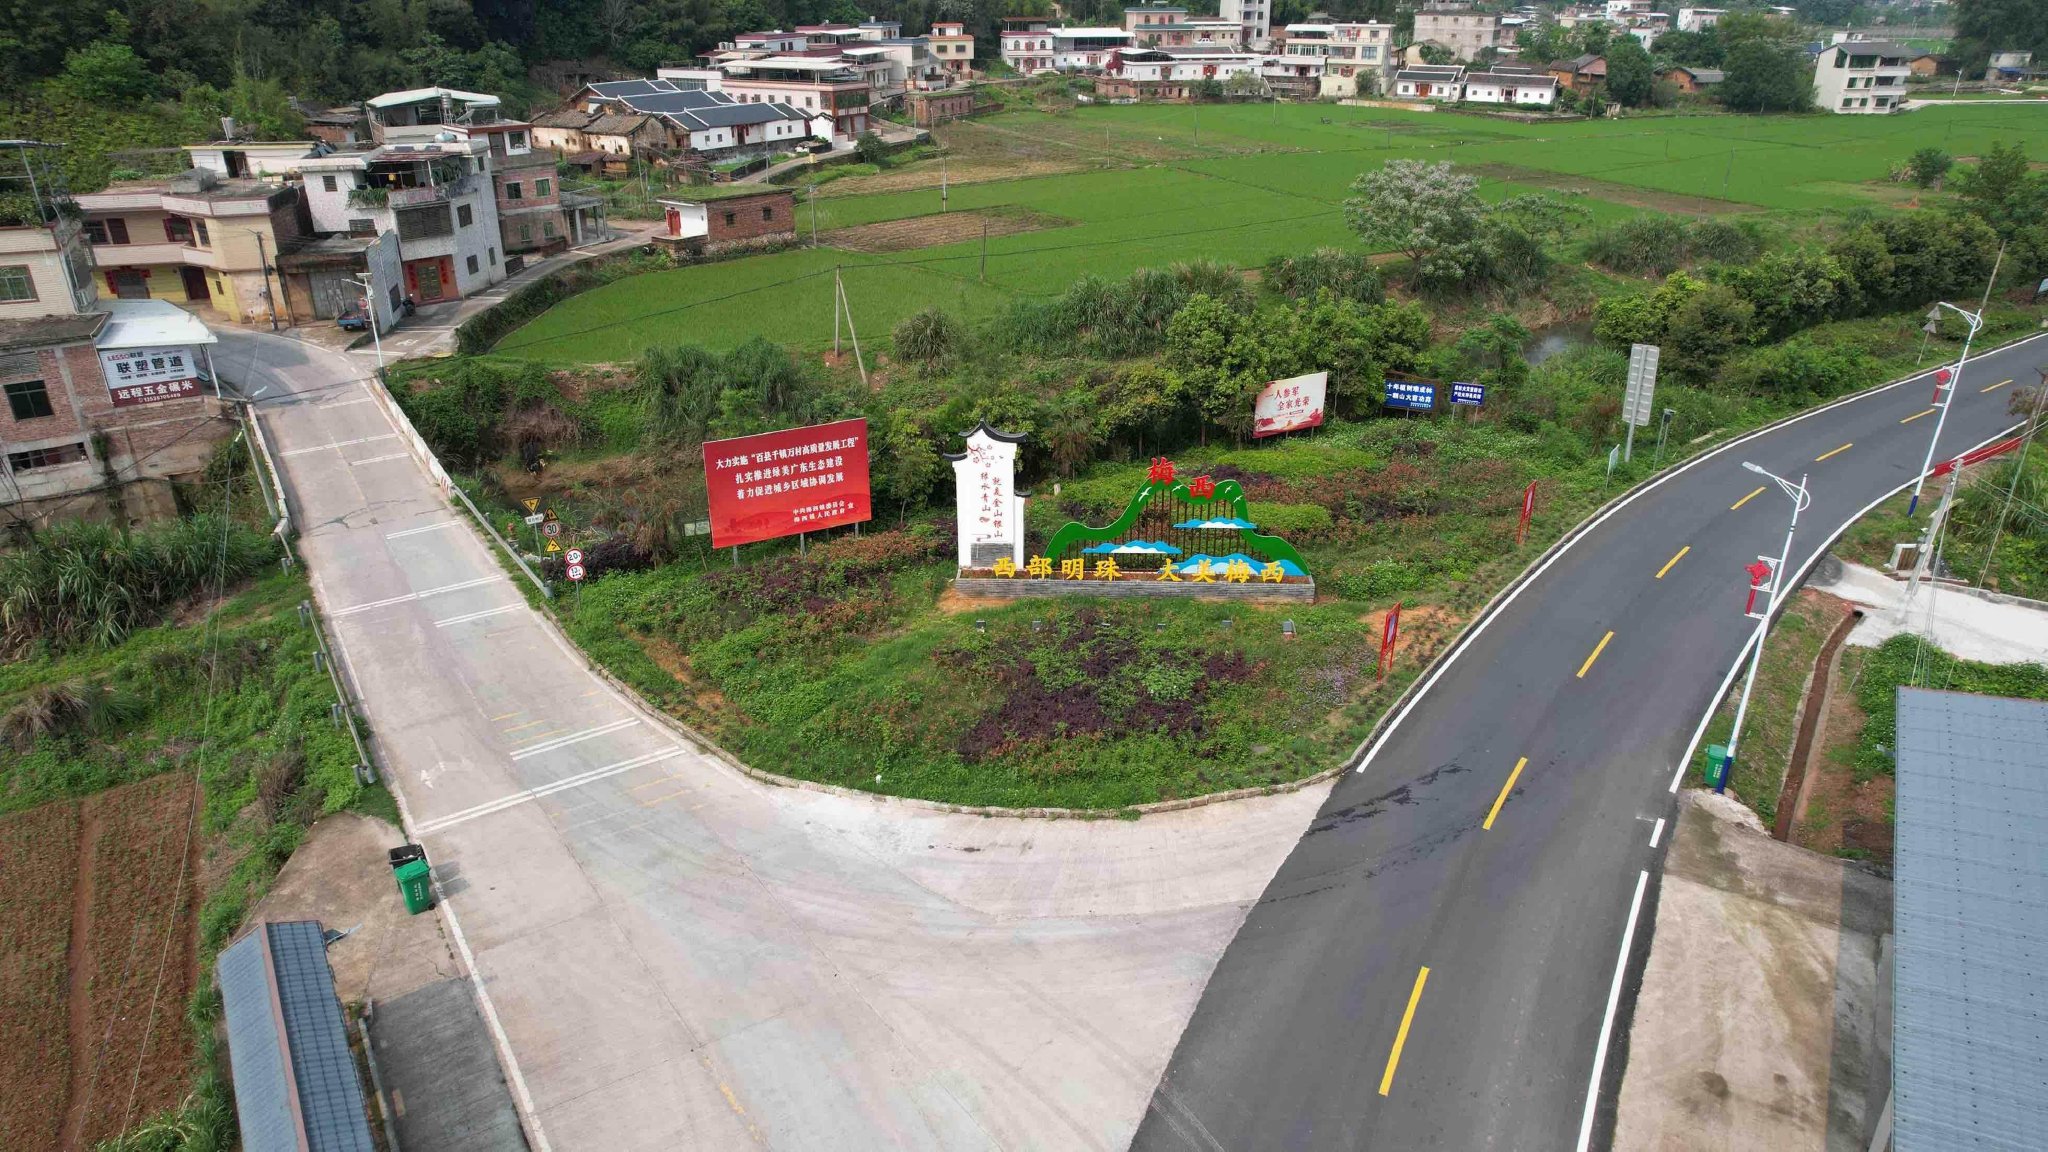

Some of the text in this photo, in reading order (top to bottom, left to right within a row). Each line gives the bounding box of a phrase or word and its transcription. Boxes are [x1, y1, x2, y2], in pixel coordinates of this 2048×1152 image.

[116, 356, 183, 373] 联塑管道
[117, 380, 193, 399] 远程五金碾米
[1265, 386, 1299, 400] 一人参军
[1278, 396, 1310, 411] 全家光荣
[735, 455, 843, 484] 扎实推进绿美广东生态建设
[1145, 456, 1217, 500] 梅西
[737, 472, 844, 500] 着力促进城乡区域协调发展
[980, 471, 991, 512] 绿水青山
[992, 476, 1003, 538] 就是金山银山
[547, 524, 557, 535] 30
[993, 555, 1122, 581] 西部明珠
[1155, 558, 1286, 584] 大美梅西
